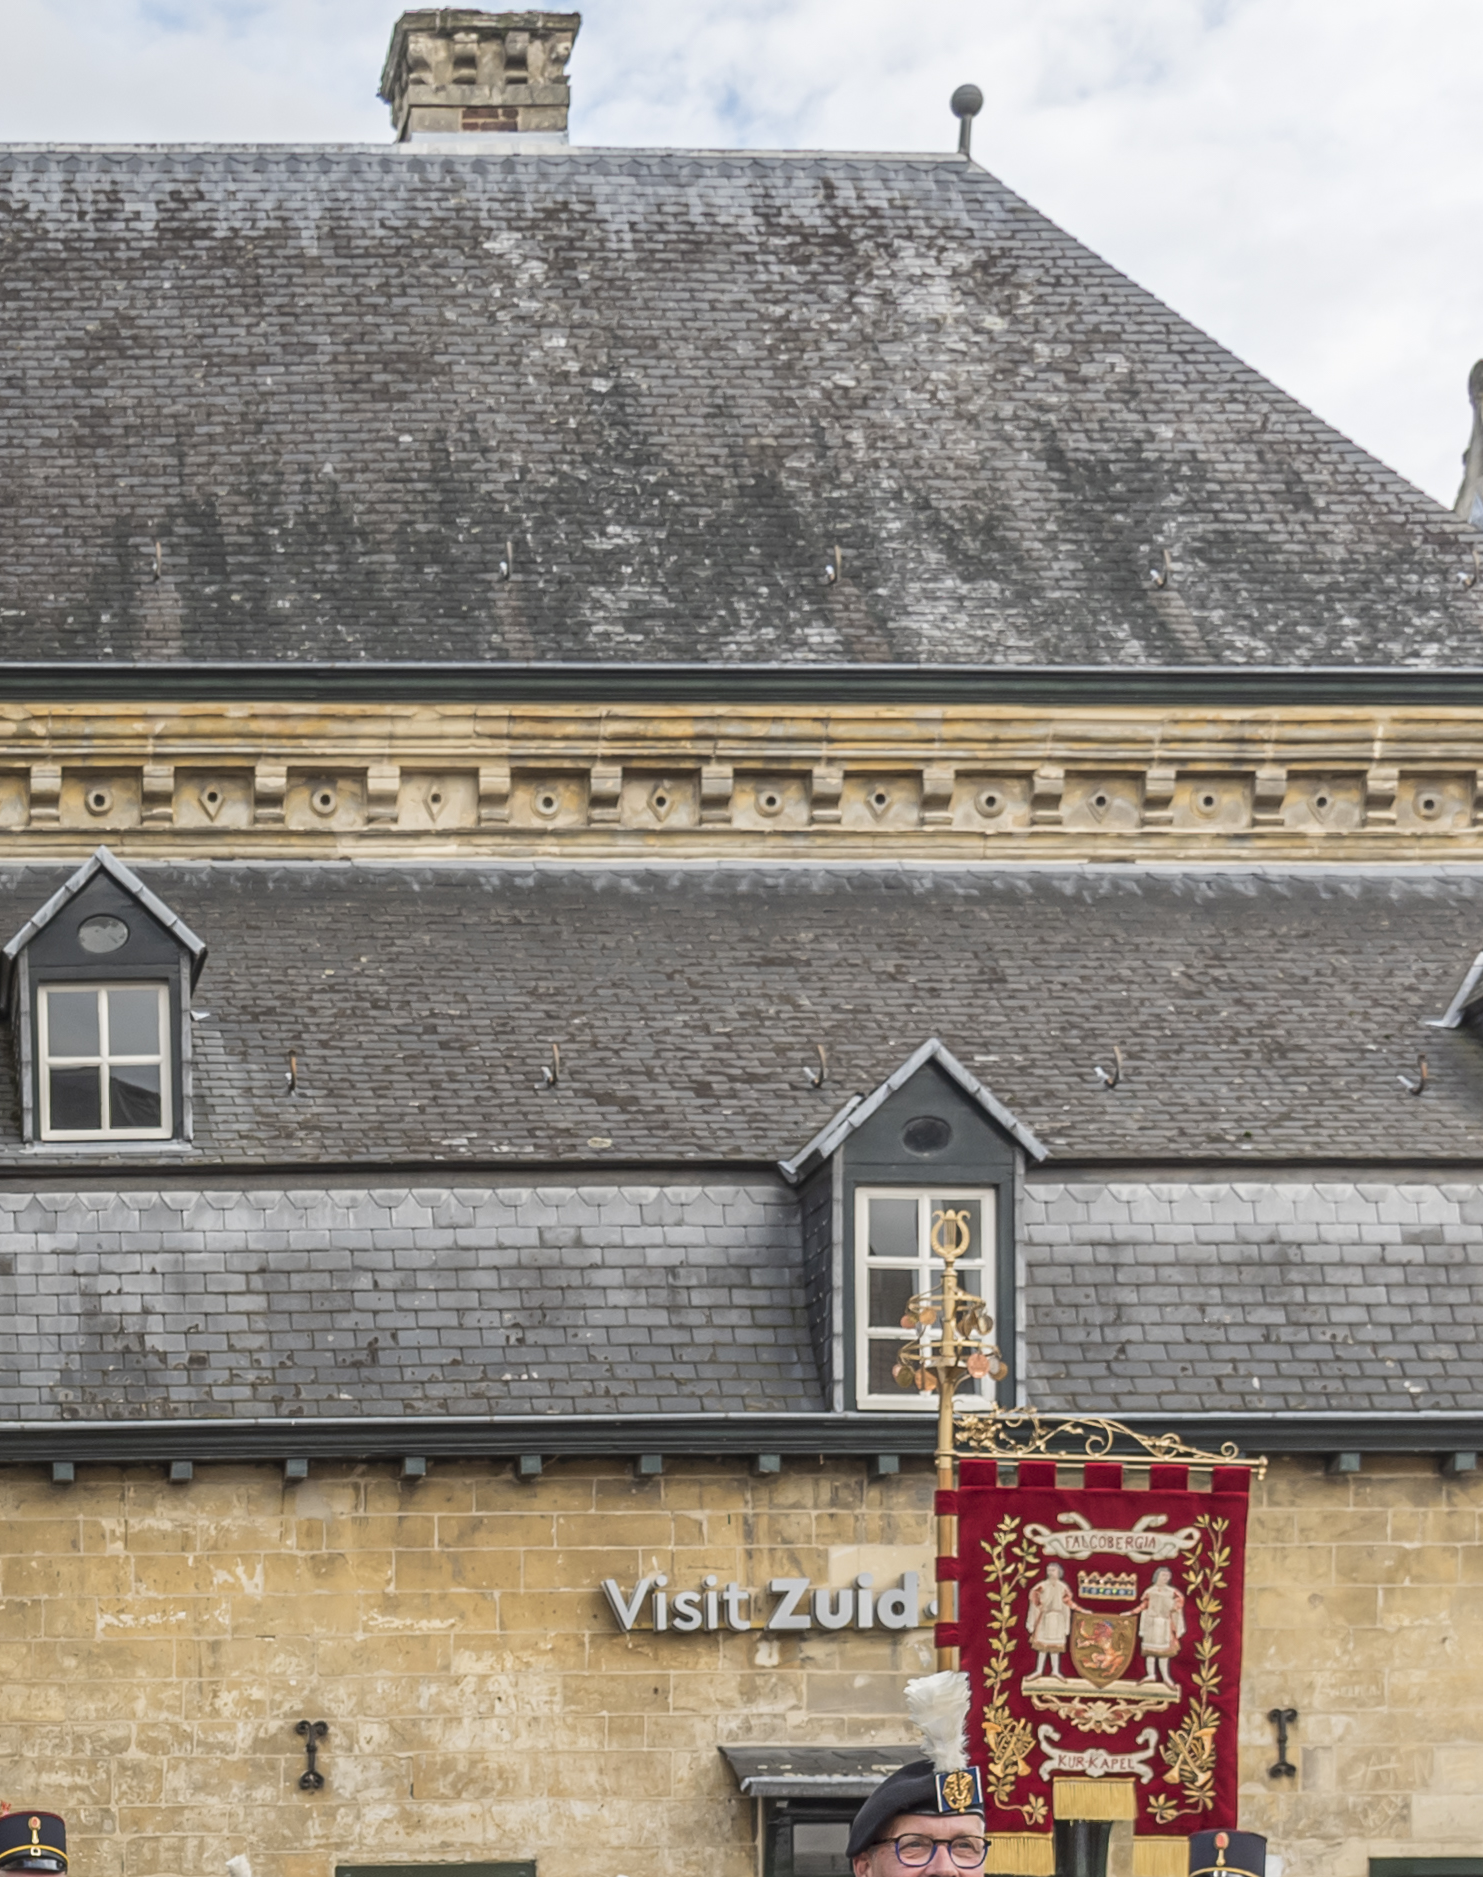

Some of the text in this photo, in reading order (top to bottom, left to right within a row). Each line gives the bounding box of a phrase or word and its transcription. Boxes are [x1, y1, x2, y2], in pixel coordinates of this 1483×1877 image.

[1065, 1535, 1157, 1550] FALCOBERGIA
[601, 1571, 919, 1631] Visit Zuid
